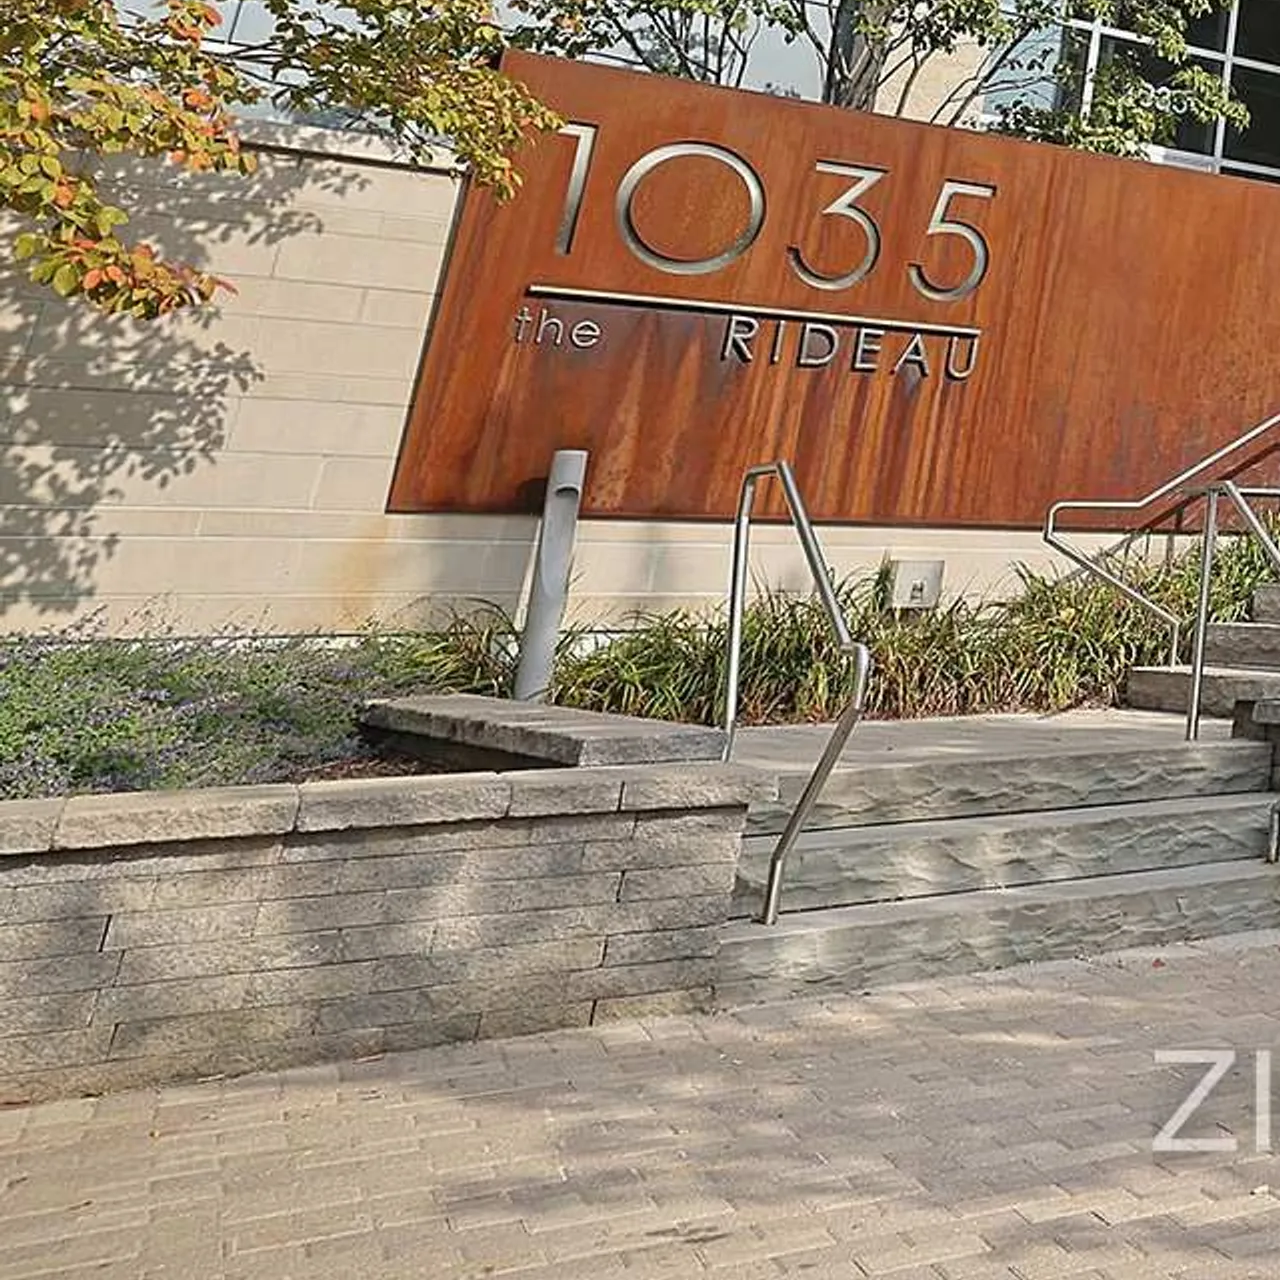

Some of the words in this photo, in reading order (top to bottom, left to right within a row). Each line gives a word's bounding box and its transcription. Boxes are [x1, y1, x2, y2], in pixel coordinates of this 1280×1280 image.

[555, 122, 997, 302] 1035
[515, 306, 602, 349] the
[720, 315, 979, 380] RIDEAU
